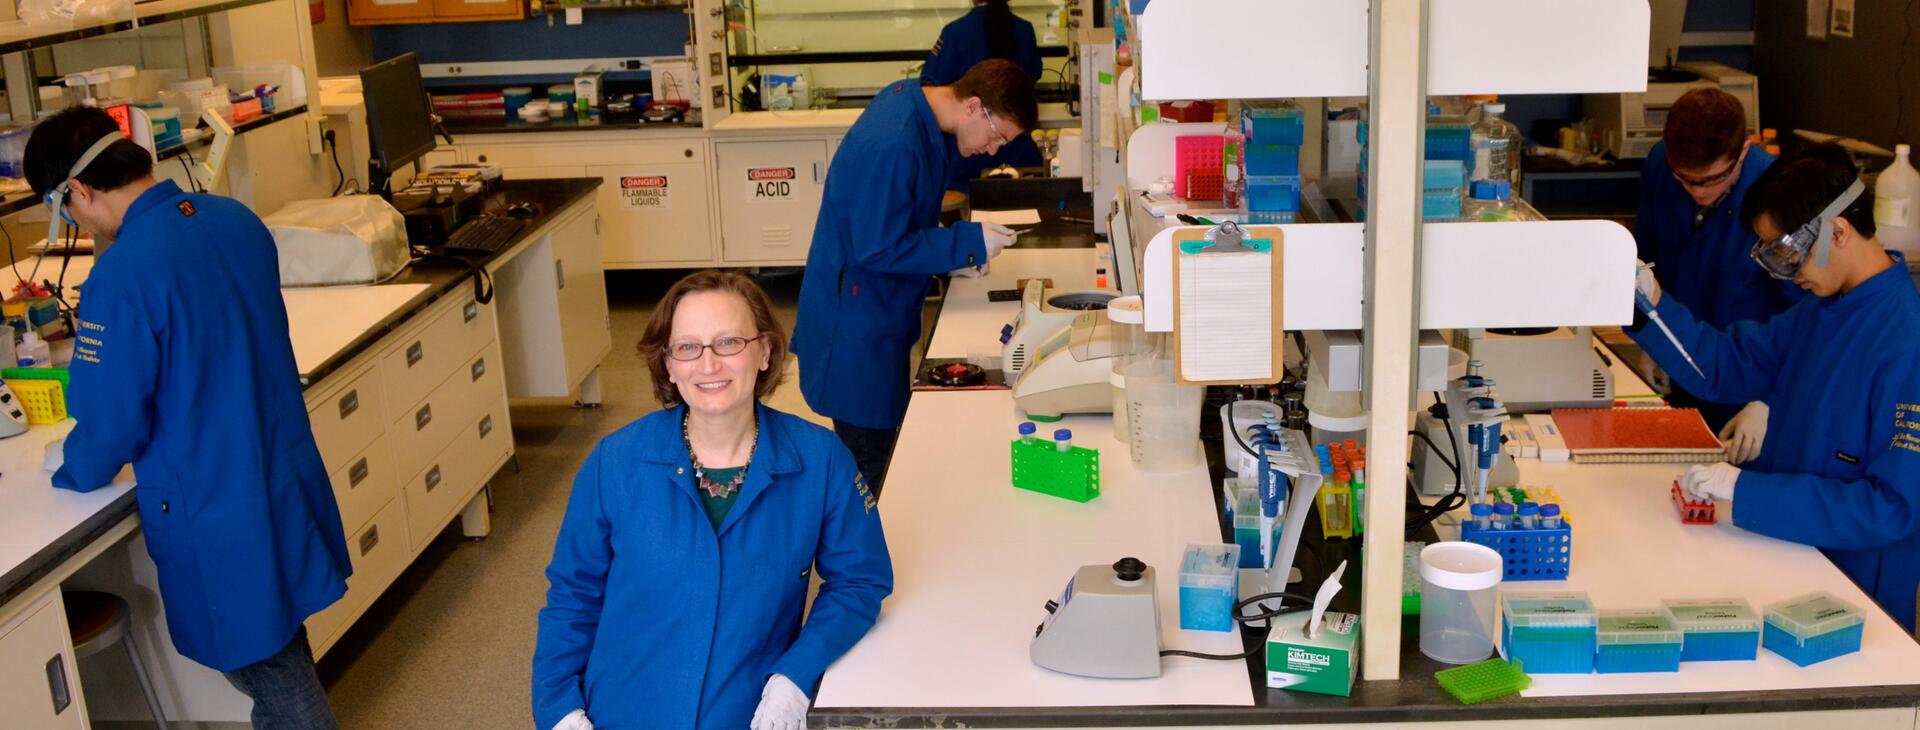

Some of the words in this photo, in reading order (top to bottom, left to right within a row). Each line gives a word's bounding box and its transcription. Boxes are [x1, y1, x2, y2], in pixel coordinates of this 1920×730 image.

[753, 170, 788, 179] DANGER
[626, 179, 660, 187] DANGER
[622, 188, 668, 198] FLAMMABLE
[756, 181, 790, 197] ACID
[631, 197, 660, 206] LIQUIDS
[81, 321, 105, 331] ERSITY
[79, 336, 103, 346] ORNIA
[1287, 651, 1330, 662] KIMTECH
